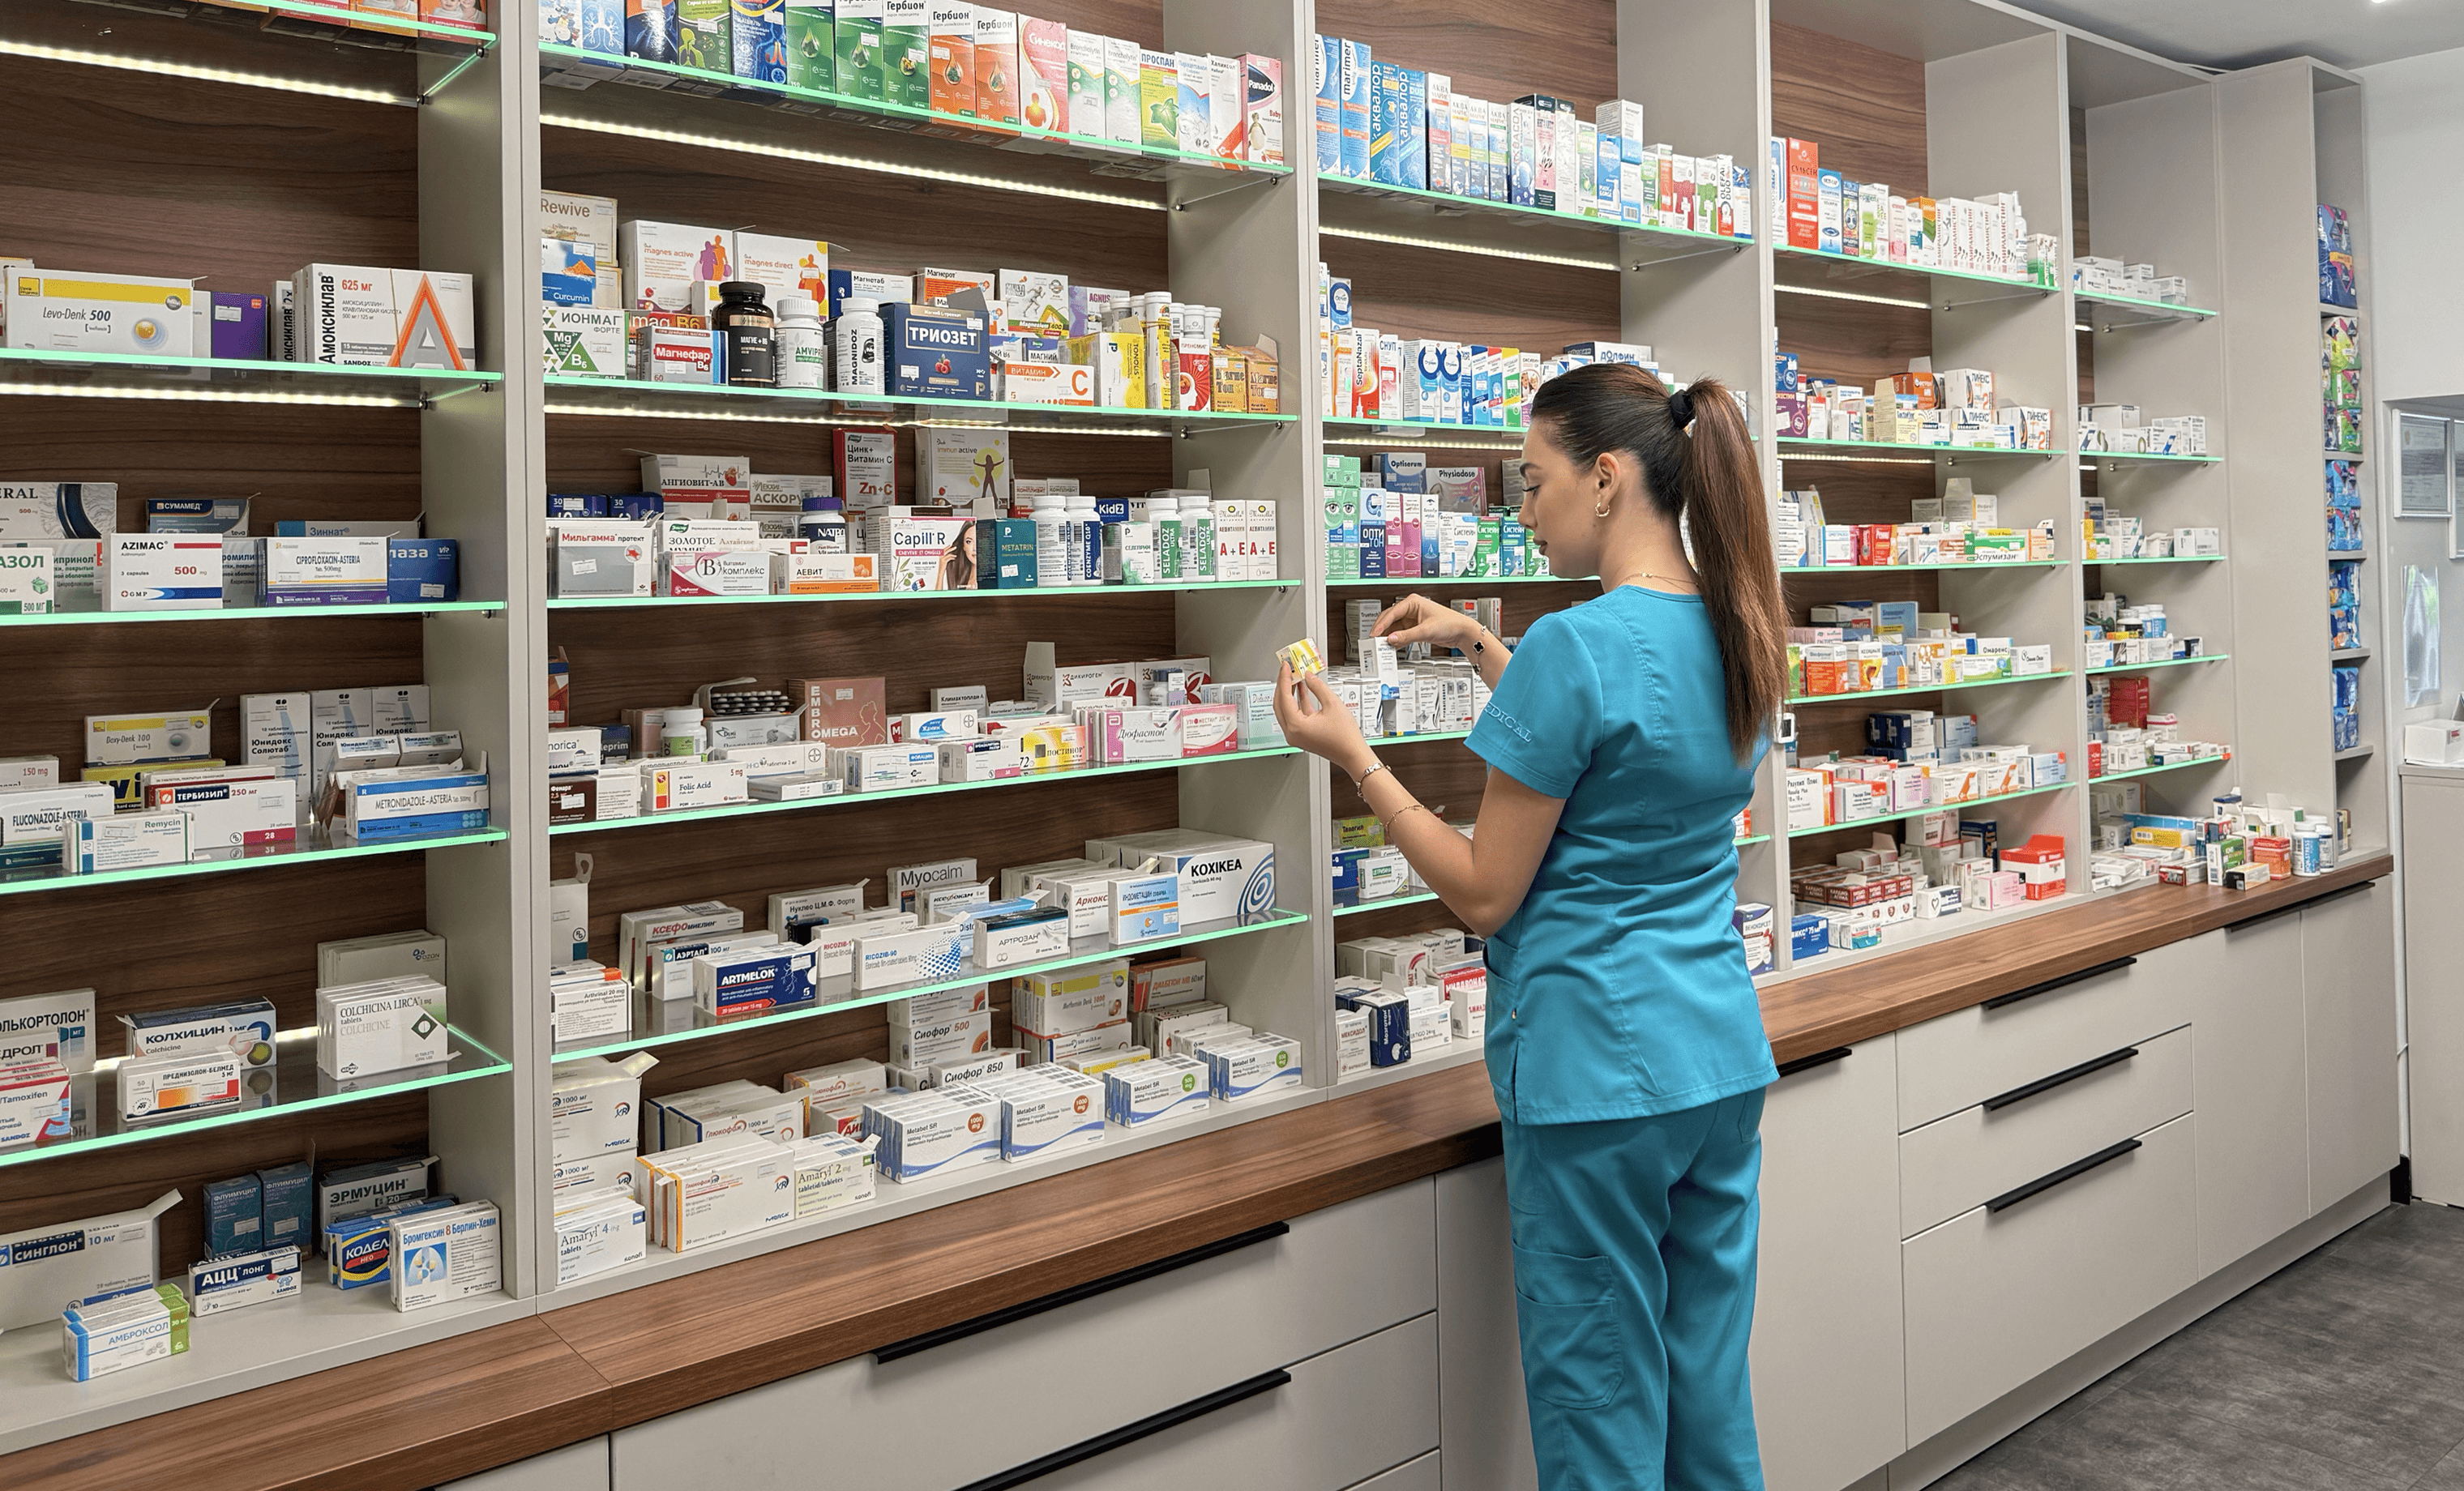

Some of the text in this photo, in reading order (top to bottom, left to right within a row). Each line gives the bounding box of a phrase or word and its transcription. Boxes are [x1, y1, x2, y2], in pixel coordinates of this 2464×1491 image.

[887, 1, 925, 13] Гербион
[933, 11, 970, 23] Гербион
[977, 19, 1012, 32] Гербион
[1141, 53, 1174, 68] ПРОСПАН
[1343, 41, 1351, 96] marimer
[1248, 79, 1273, 92] Panadol
[541, 199, 590, 217] Rewive
[644, 247, 694, 258] magnes active
[745, 258, 794, 270] magnes direct
[927, 269, 956, 278] Магнерот
[341, 280, 358, 291] 625
[853, 276, 885, 284] Магнетаб
[554, 293, 589, 302] Curcumin
[43, 307, 111, 322] Levo-Denk 500
[562, 313, 619, 326] ИОНМАГ
[909, 327, 977, 346] ТРИОЗЕТ
[657, 347, 710, 361] Магнефар
[1601, 350, 1634, 361] ДОЛФИН
[1011, 367, 1046, 376] ВИТАМИН
[848, 455, 884, 464] Витамин
[1391, 459, 1422, 468] Optiserum
[1439, 469, 1476, 479] Physiodose
[165, 502, 201, 511] СУМАМЕД
[553, 498, 563, 506] 30
[614, 498, 623, 506] 30
[310, 528, 344, 536] Зиннат
[563, 533, 615, 542] Мильгамма
[122, 542, 164, 550] AZIMAC
[669, 537, 716, 545] ЗОЛОТОЕ
[297, 555, 361, 565] CIPROFLOXACIN-ASTERIA
[174, 566, 197, 575] 500
[722, 566, 764, 576] комплекс
[316, 731, 354, 740] Юнидокс
[376, 728, 413, 736] Юнидокс
[811, 726, 858, 738] OMEGA
[1118, 728, 1166, 741] Дюфастон
[251, 737, 292, 747] Юнидокс
[251, 746, 289, 754] Солютаб
[1046, 746, 1084, 756] ПОСТИНОР
[24, 767, 35, 776] 150
[679, 781, 712, 791] Folic Acid
[178, 789, 224, 801] ТЕРБИЗИЛ
[231, 788, 246, 797] 250
[144, 819, 181, 830] Remycin
[265, 832, 276, 840] 28
[1191, 858, 1243, 878] KOXIKEA
[901, 865, 964, 888] Myocalm
[676, 947, 704, 959] АЭРТАЛ
[721, 968, 775, 986] ARTMELOK
[340, 998, 419, 1019] COLCHICINA LIRCA
[340, 1016, 362, 1025] tablets
[340, 1019, 391, 1036] COLCHICINE
[914, 1020, 970, 1040] Сиофор 500
[146, 1026, 225, 1045] КОЛХИЦИН
[146, 1045, 182, 1055] Colchicine
[944, 1061, 1003, 1083] Сиофор 850
[563, 1095, 578, 1104] 1000
[1016, 1107, 1036, 1116] Metabet
[906, 1121, 938, 1135] Metabet SR
[1, 1132, 30, 1143] SANDOZ
[565, 1166, 580, 1174] 1000
[798, 1166, 832, 1184] Amaryl
[330, 1178, 407, 1203] ЭРМУЦИН
[403, 1215, 497, 1246] Бромгексин 8 Берлин-Хеми
[561, 1225, 599, 1248] Amaryl
[15, 1233, 116, 1262] СИНГЛОН 10 мг
[560, 1245, 582, 1256] tablets
[202, 1265, 237, 1287] АЦЦ
[109, 1321, 169, 1345] АМБРОКСОЛ
